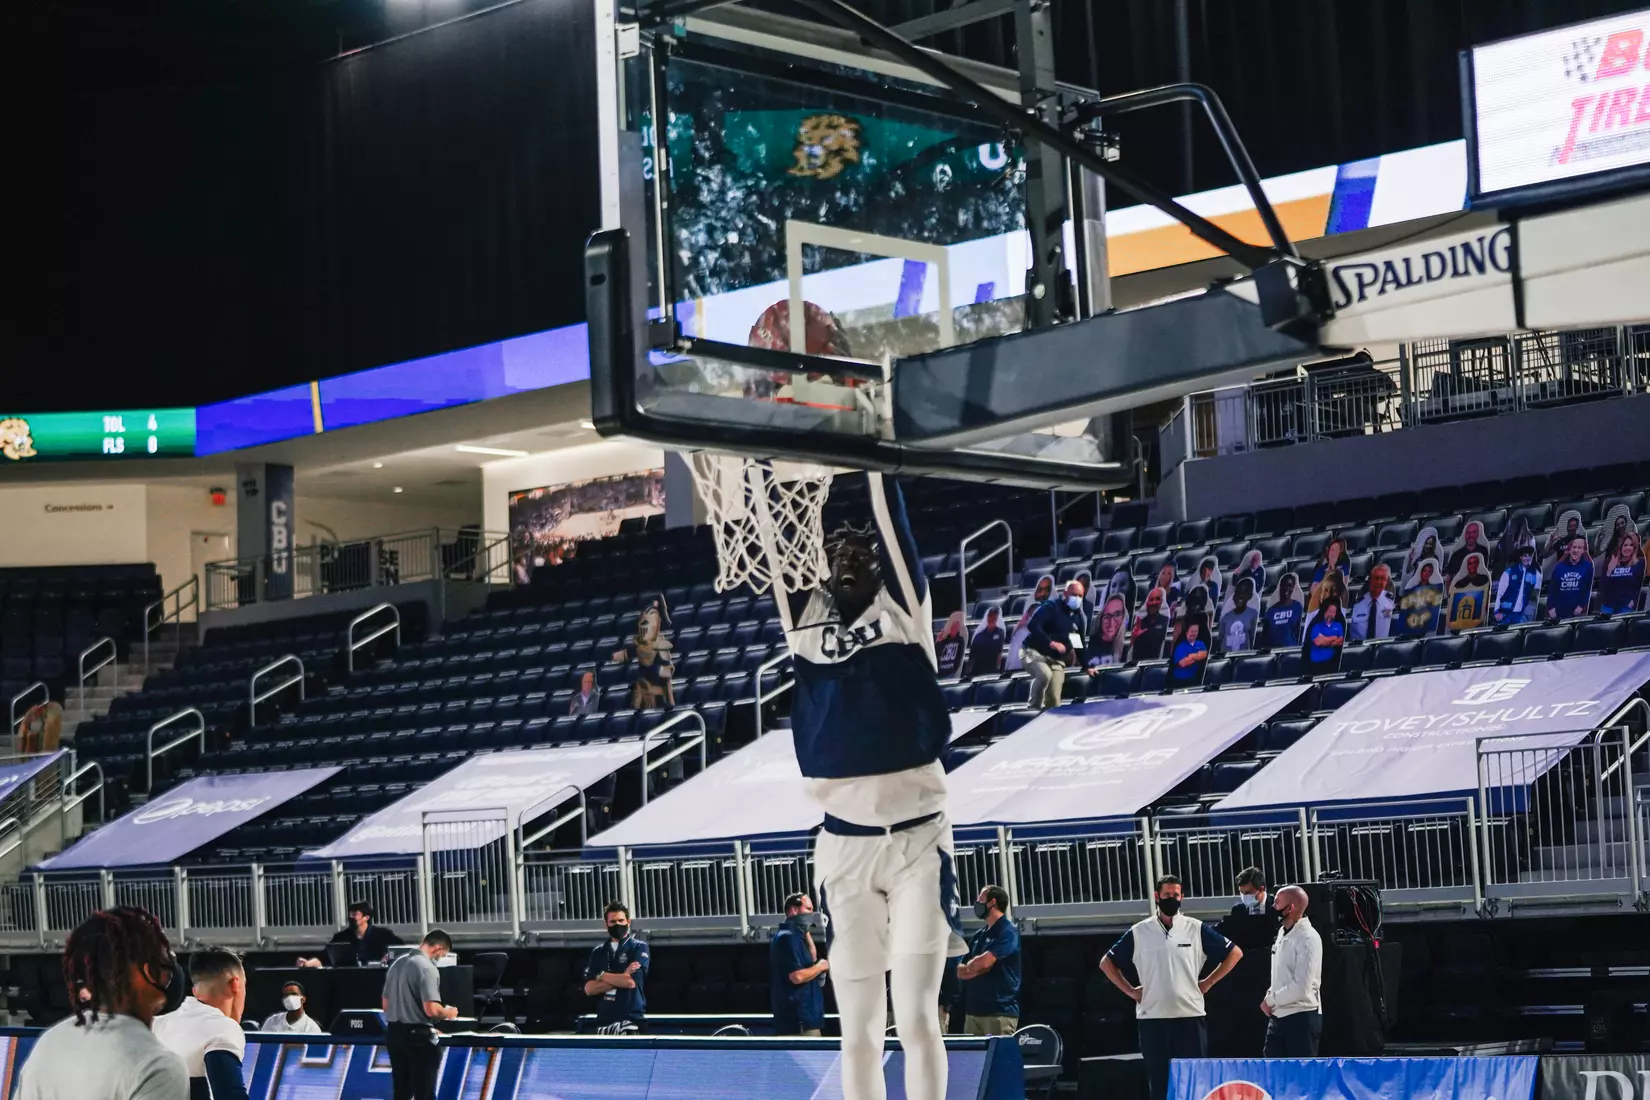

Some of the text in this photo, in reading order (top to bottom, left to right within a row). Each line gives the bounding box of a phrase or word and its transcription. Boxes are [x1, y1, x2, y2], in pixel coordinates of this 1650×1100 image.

[1332, 226, 1511, 311] SPALDING
[103, 413, 157, 433] TOL 4
[103, 436, 125, 454] FLS
[271, 501, 289, 574] CBU
[1274, 610, 1293, 619] CBU
[1332, 700, 1600, 736] TOVEY/SHULTZ
[350, 1019, 364, 1029] POSS
